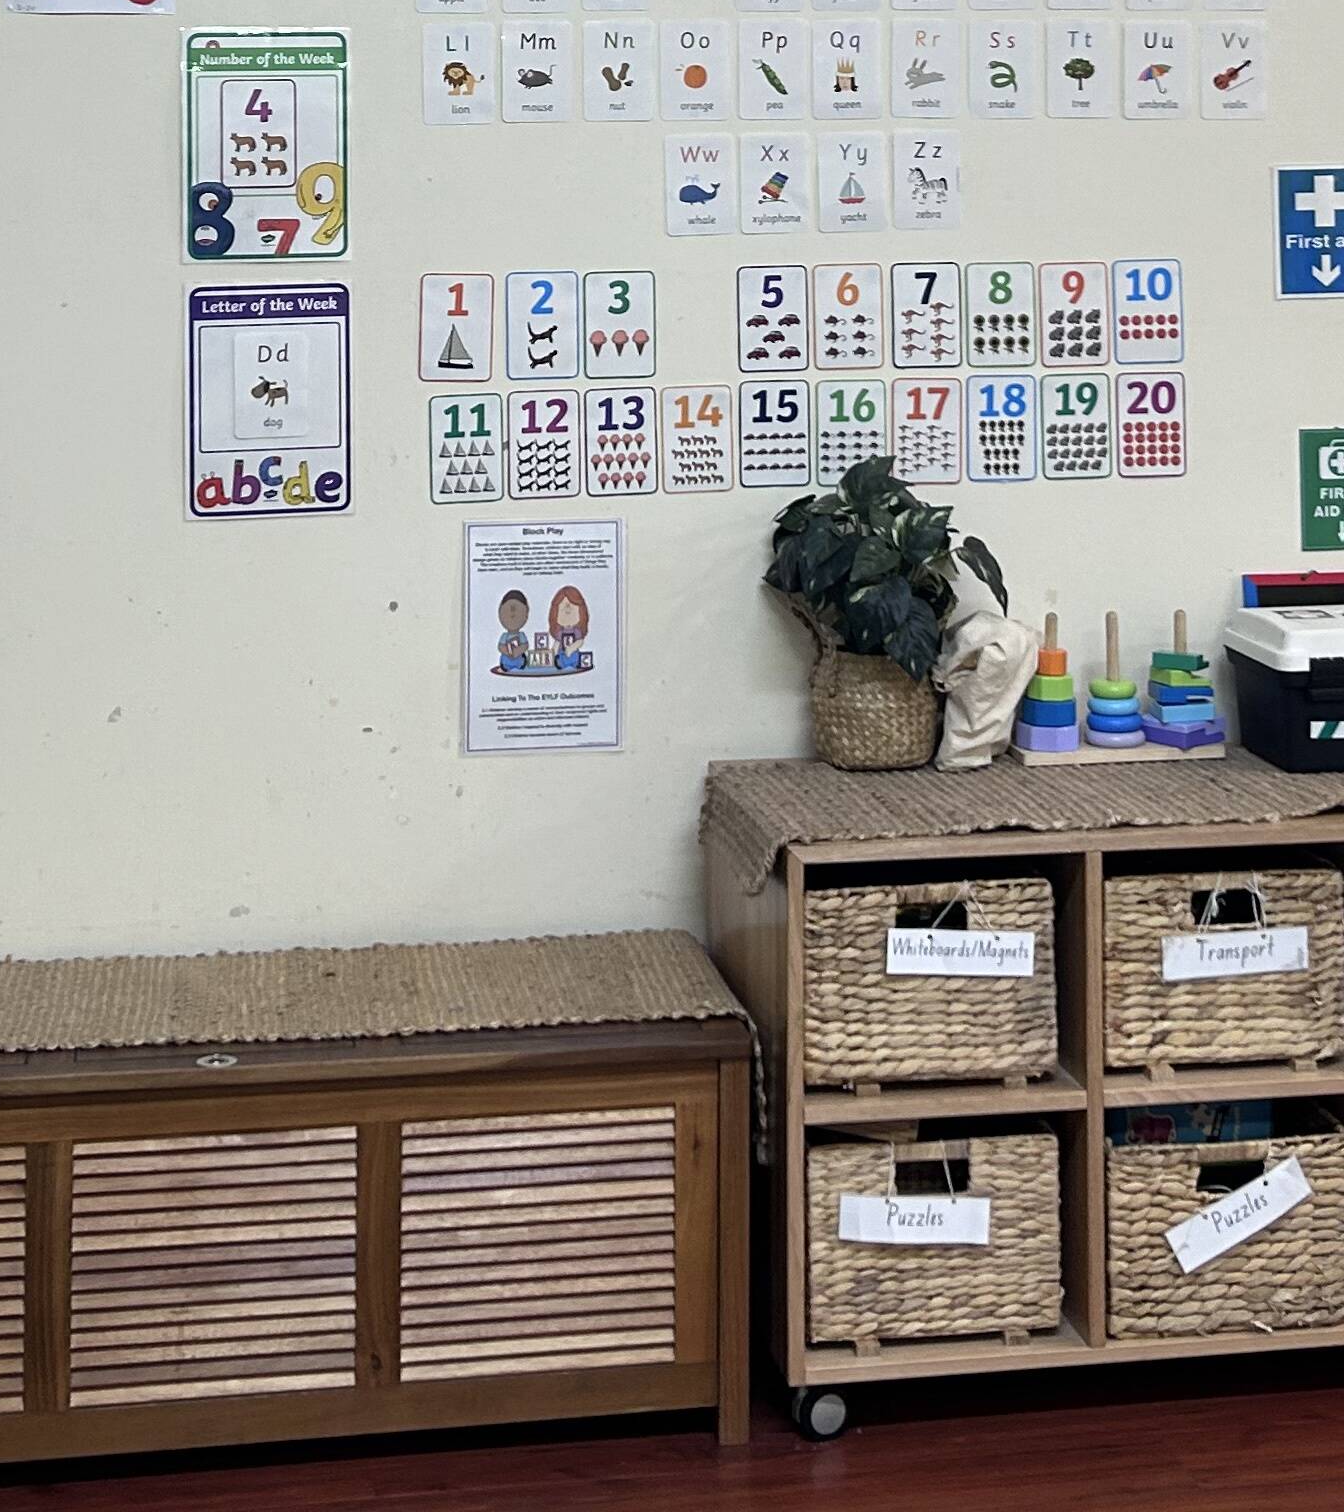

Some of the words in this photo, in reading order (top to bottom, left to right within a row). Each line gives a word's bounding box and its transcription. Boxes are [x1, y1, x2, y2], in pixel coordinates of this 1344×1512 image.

[200, 53, 253, 66] Number
[256, 53, 270, 68] of
[274, 52, 296, 65] the
[301, 52, 335, 65] Week
[245, 89, 273, 122] 4
[451, 104, 471, 115] lion
[521, 104, 554, 113] mouse
[680, 102, 714, 113] orange
[688, 214, 716, 224] whale
[752, 214, 801, 225] xylophone
[840, 212, 867, 223] yacht
[915, 210, 942, 219] zebra
[1286, 235, 1330, 249] First
[447, 282, 468, 317] 1
[531, 280, 554, 315] 2
[608, 280, 630, 314] 3
[760, 275, 783, 308] 5
[989, 271, 1012, 304] 8
[1062, 271, 1085, 304] 9
[1126, 268, 1173, 301] 10
[202, 300, 246, 314] Letter
[250, 299, 265, 315] of
[270, 298, 294, 311] the
[298, 296, 338, 310] Week
[752, 388, 798, 423] 15
[907, 387, 950, 420] 17
[1127, 380, 1176, 414] 20
[263, 418, 284, 429] dog
[444, 403, 491, 439] 11
[598, 396, 644, 431] 13
[1313, 506, 1341, 518] AID
[522, 527, 545, 536] Block
[547, 527, 564, 536] Play
[892, 936, 1029, 966] Whiteboards/Magnets
[1196, 937, 1274, 967] Transport
[886, 1201, 944, 1228] Puzzles
[1212, 1191, 1270, 1234] Puzzles
